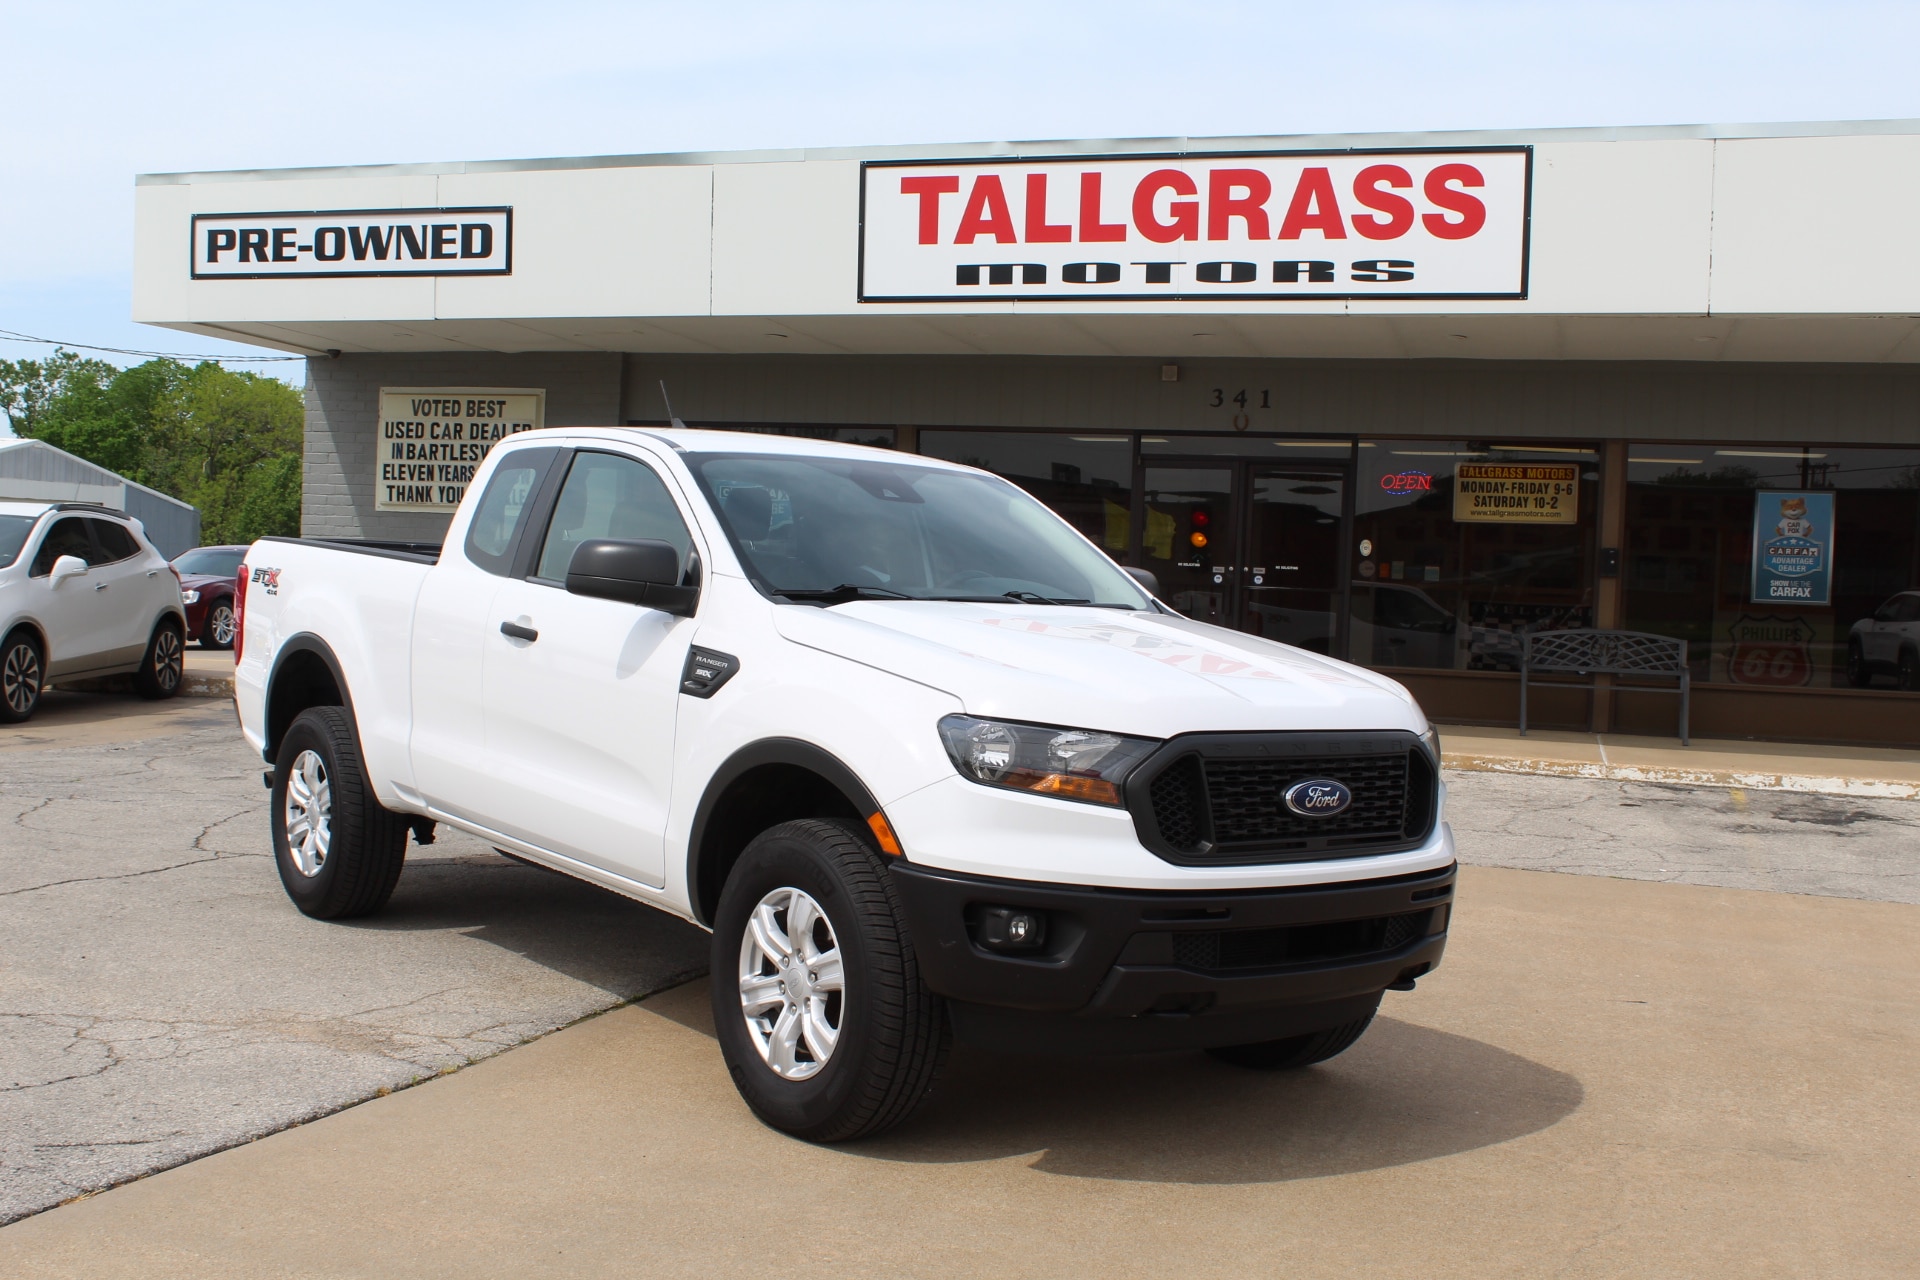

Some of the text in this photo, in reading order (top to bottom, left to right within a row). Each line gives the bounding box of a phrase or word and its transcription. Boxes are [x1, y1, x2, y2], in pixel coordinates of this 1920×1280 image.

[900, 163, 1487, 245] TALLGRASS
[206, 223, 493, 263] PRE-OWNED
[956, 260, 1415, 286] MOTORS
[1209, 388, 1271, 409] 341
[411, 399, 506, 418] VOTED BEST
[385, 421, 425, 439] USED
[430, 422, 463, 440] CAR
[391, 442, 494, 461] IN BARTLESV
[383, 463, 476, 482] ELEVEN YEARS
[1462, 467, 1573, 480] TALLGRASS MOTORS
[1381, 474, 1432, 490] OPEN
[1460, 481, 1573, 496] MONDAY-FRIDAY 9-6
[386, 485, 464, 504] THANK YOU
[1474, 495, 1558, 510] SATURDAY 10-2
[1470, 509, 1562, 518] www.tallgrassmotors.com
[1769, 547, 1818, 556] CARFAX
[1771, 557, 1815, 565] ADVANTAGE
[1778, 564, 1807, 572] DEALER
[252, 567, 282, 588] STX
[1770, 579, 1790, 587] SHOW
[1770, 586, 1812, 598] CARFAX
[1742, 626, 1803, 642] PHILLIPS
[696, 655, 728, 669] RANGER
[1743, 649, 1797, 679] 66
[1305, 786, 1340, 808] Ford
